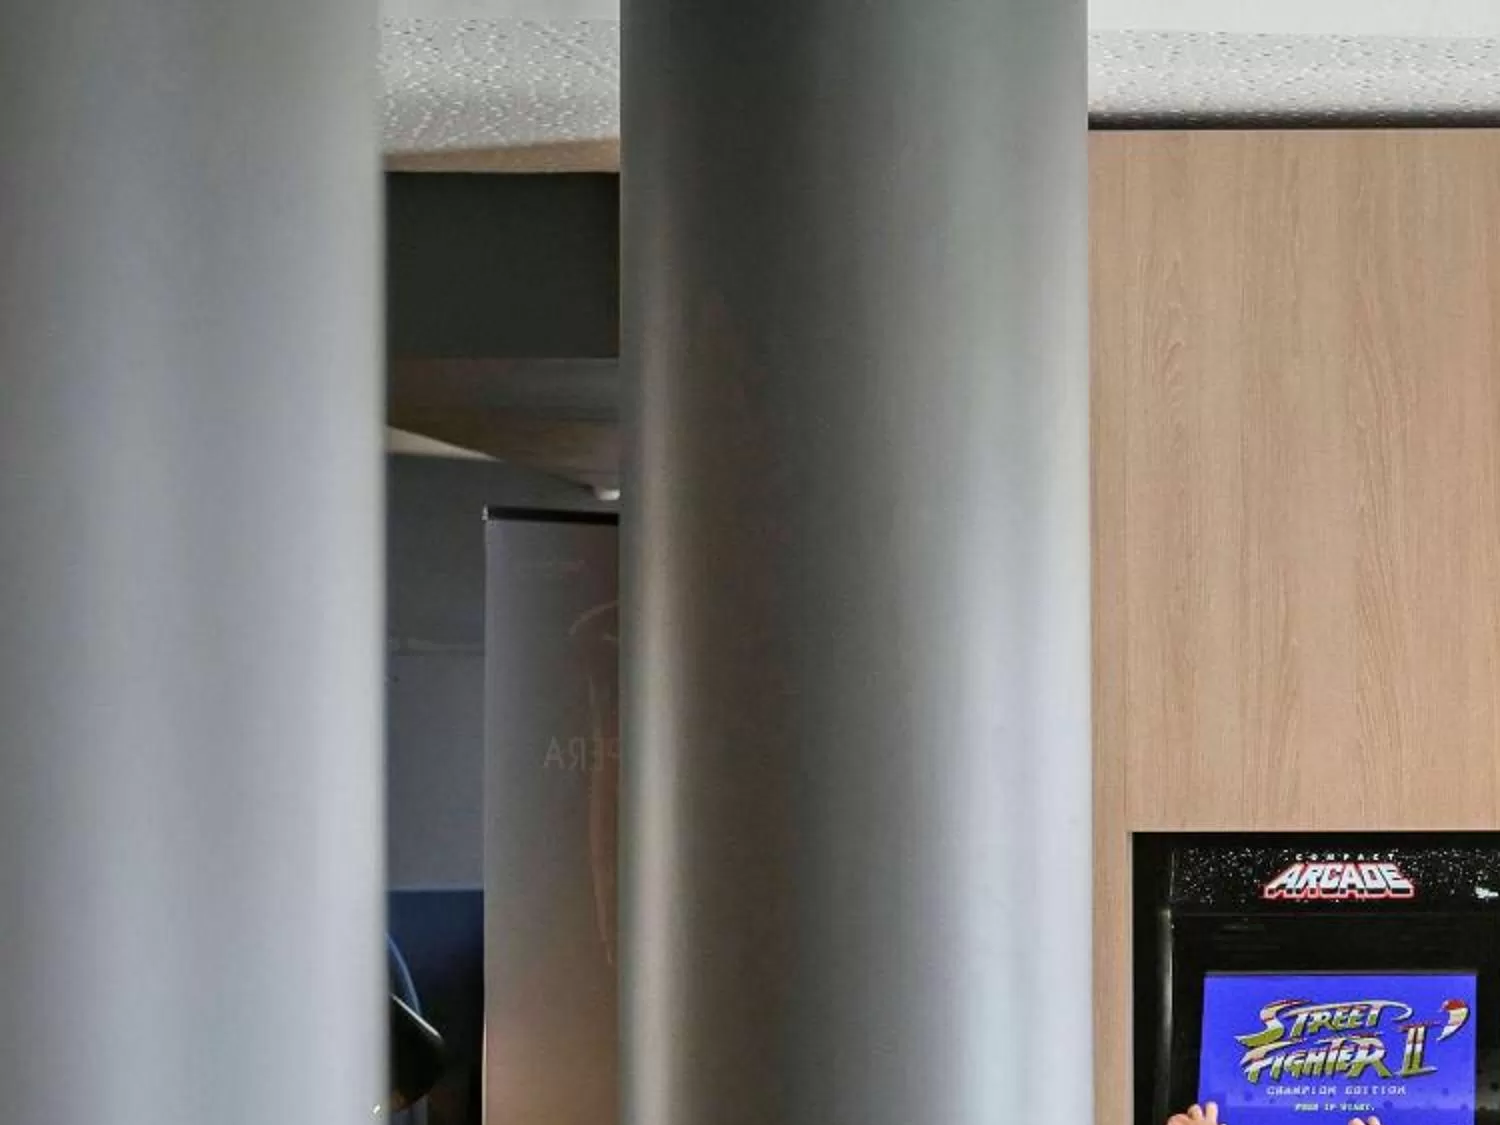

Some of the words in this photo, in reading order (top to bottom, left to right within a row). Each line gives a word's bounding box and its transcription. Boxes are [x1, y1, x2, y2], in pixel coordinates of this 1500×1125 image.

[1295, 853, 1396, 861] COMPACT
[1263, 862, 1415, 899] ARCADE
[1235, 999, 1413, 1047] STREET
[1239, 1033, 1394, 1084] FIGHTER
[1267, 1085, 1337, 1095] CHAMPION
[1345, 1085, 1407, 1095] EDITION
